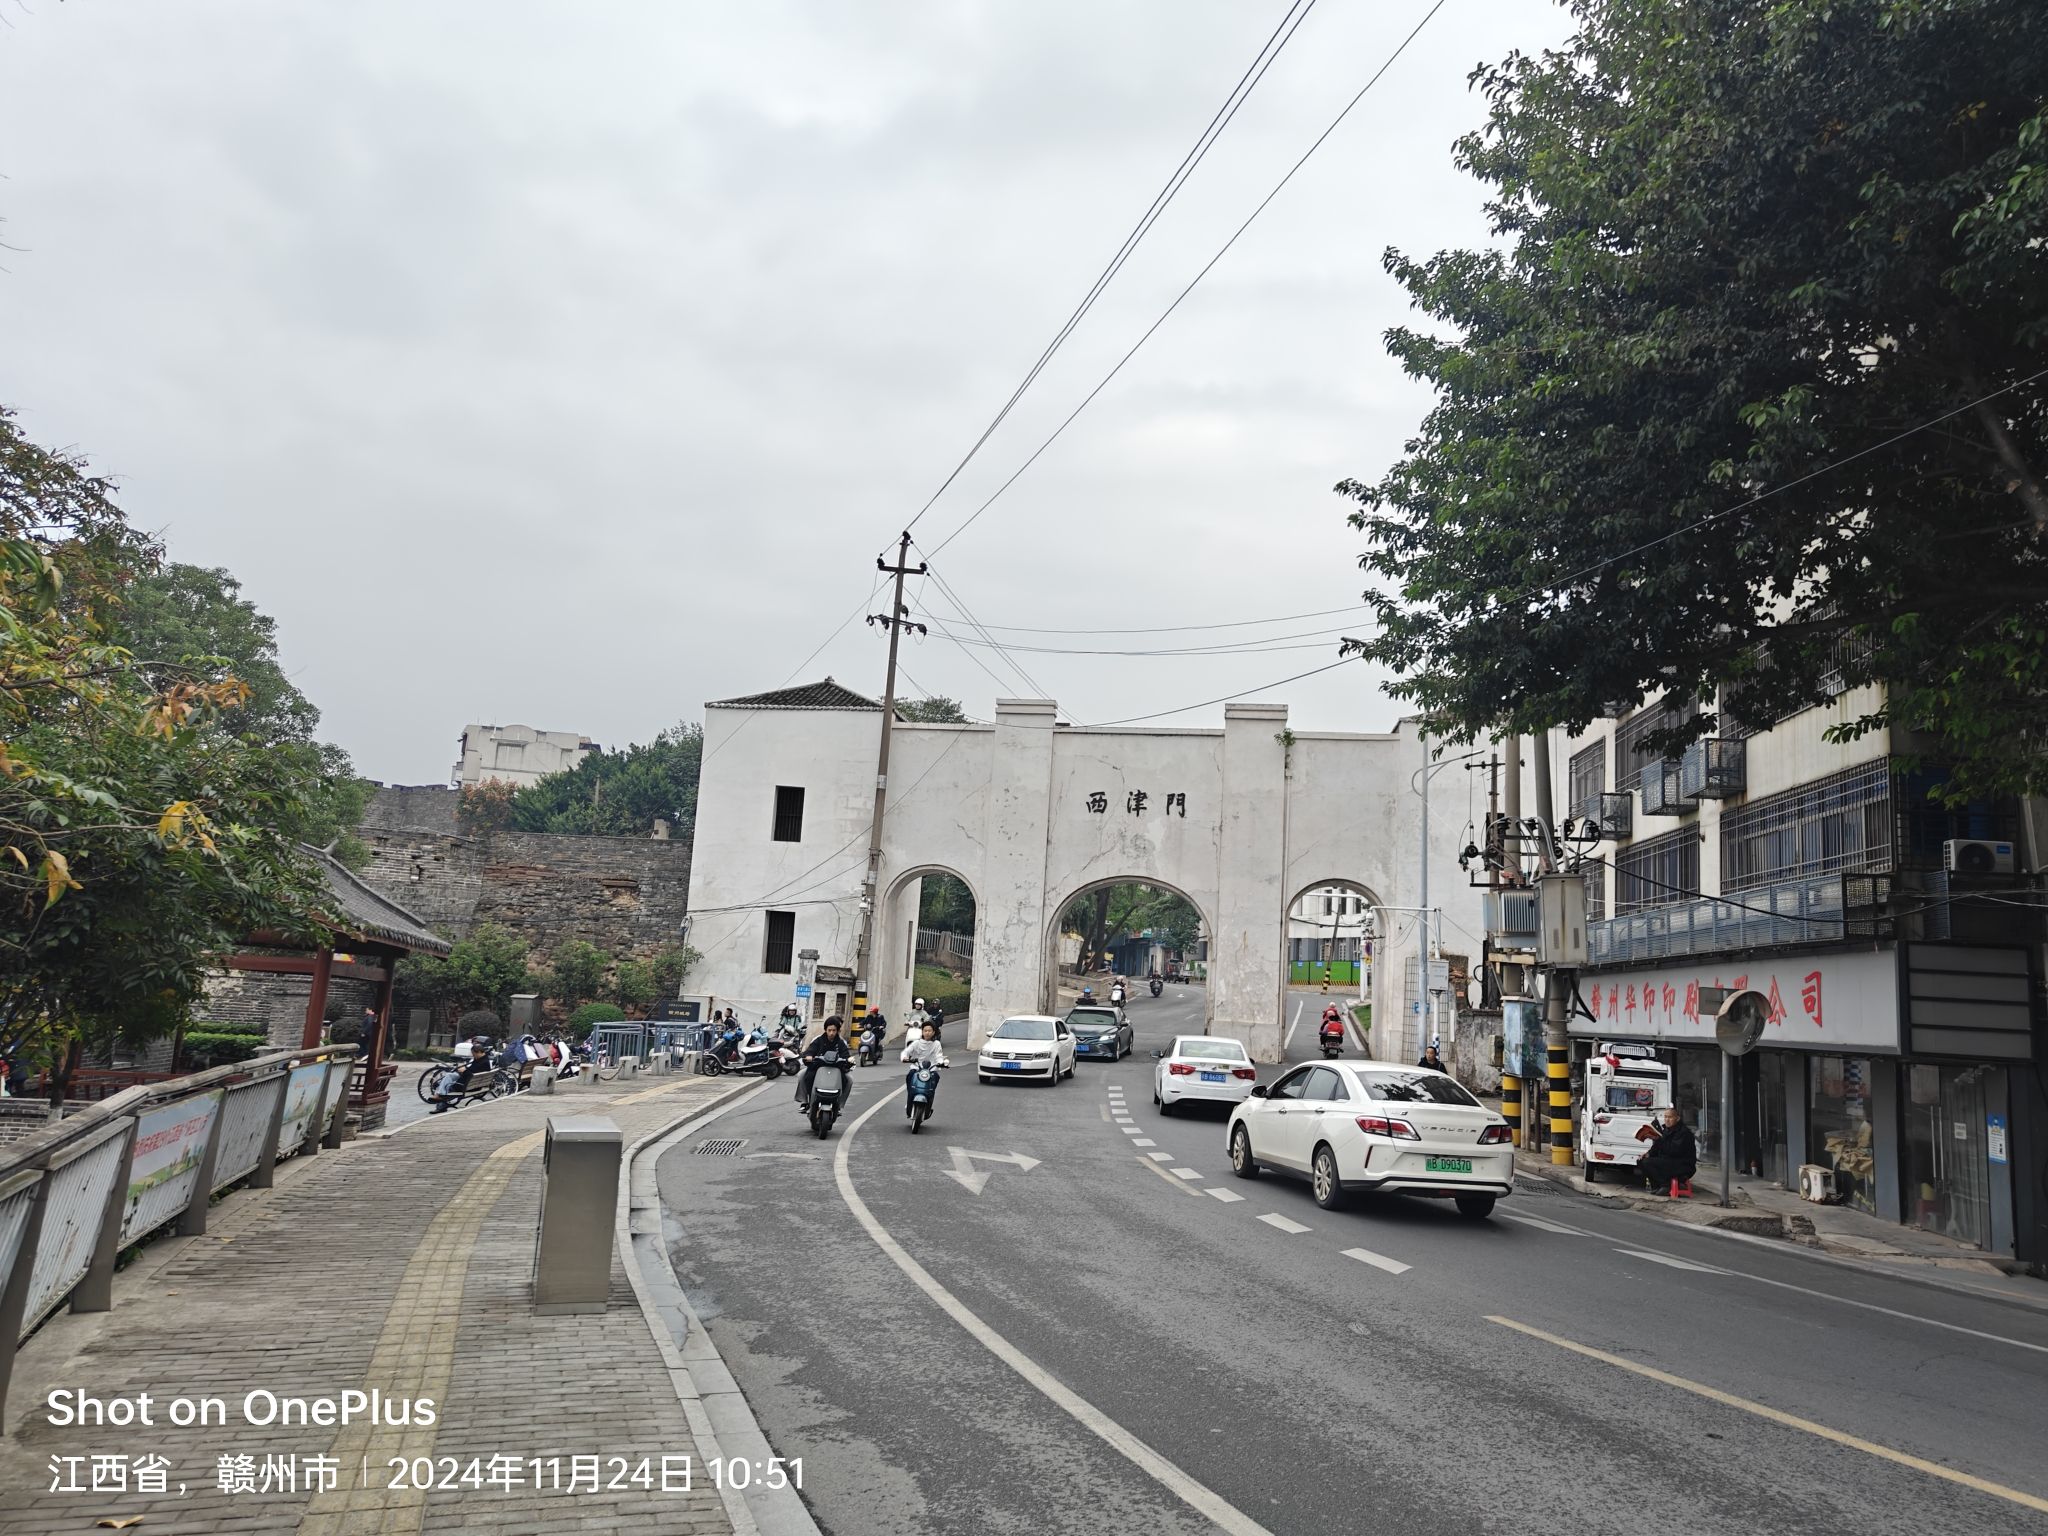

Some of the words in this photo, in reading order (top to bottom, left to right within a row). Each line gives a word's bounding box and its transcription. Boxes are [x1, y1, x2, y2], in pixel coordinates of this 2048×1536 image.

[1086, 789, 1186, 818] 西津門
[1590, 970, 1823, 1028] 赣州华印印刷公司
